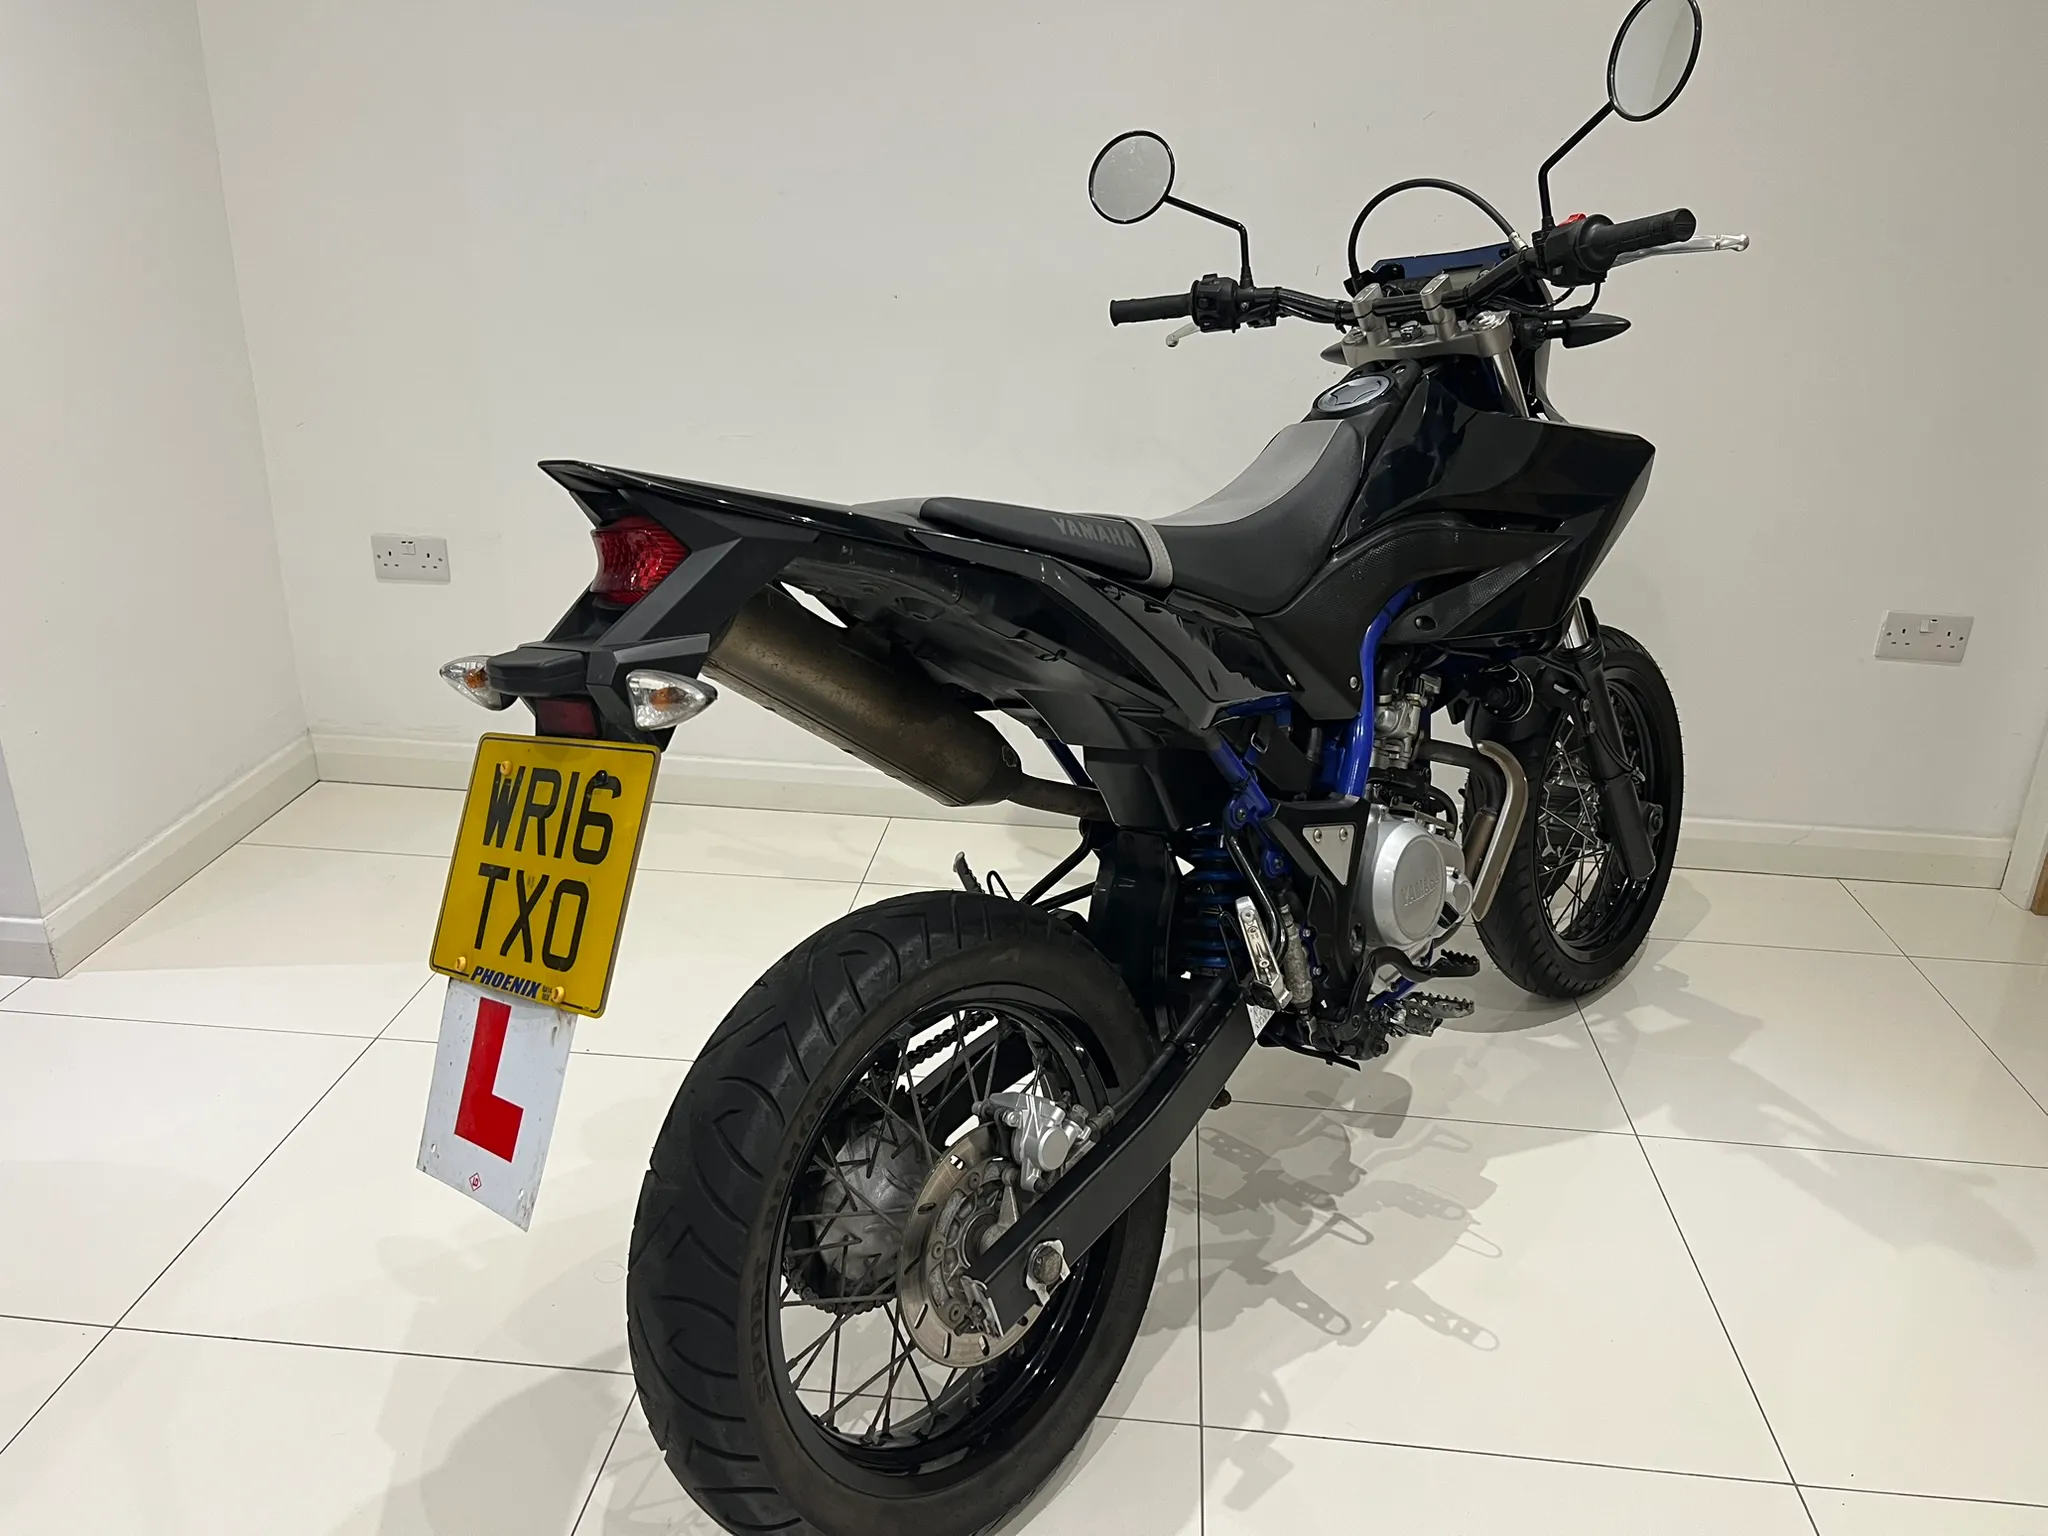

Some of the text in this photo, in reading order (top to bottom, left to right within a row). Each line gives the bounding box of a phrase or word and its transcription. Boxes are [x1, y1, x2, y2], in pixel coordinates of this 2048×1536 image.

[1051, 516, 1137, 548] YAMAHA
[483, 763, 622, 865] WR16
[474, 862, 589, 972] TXO
[470, 966, 542, 999] PHOENIX
[454, 997, 524, 1163] L
